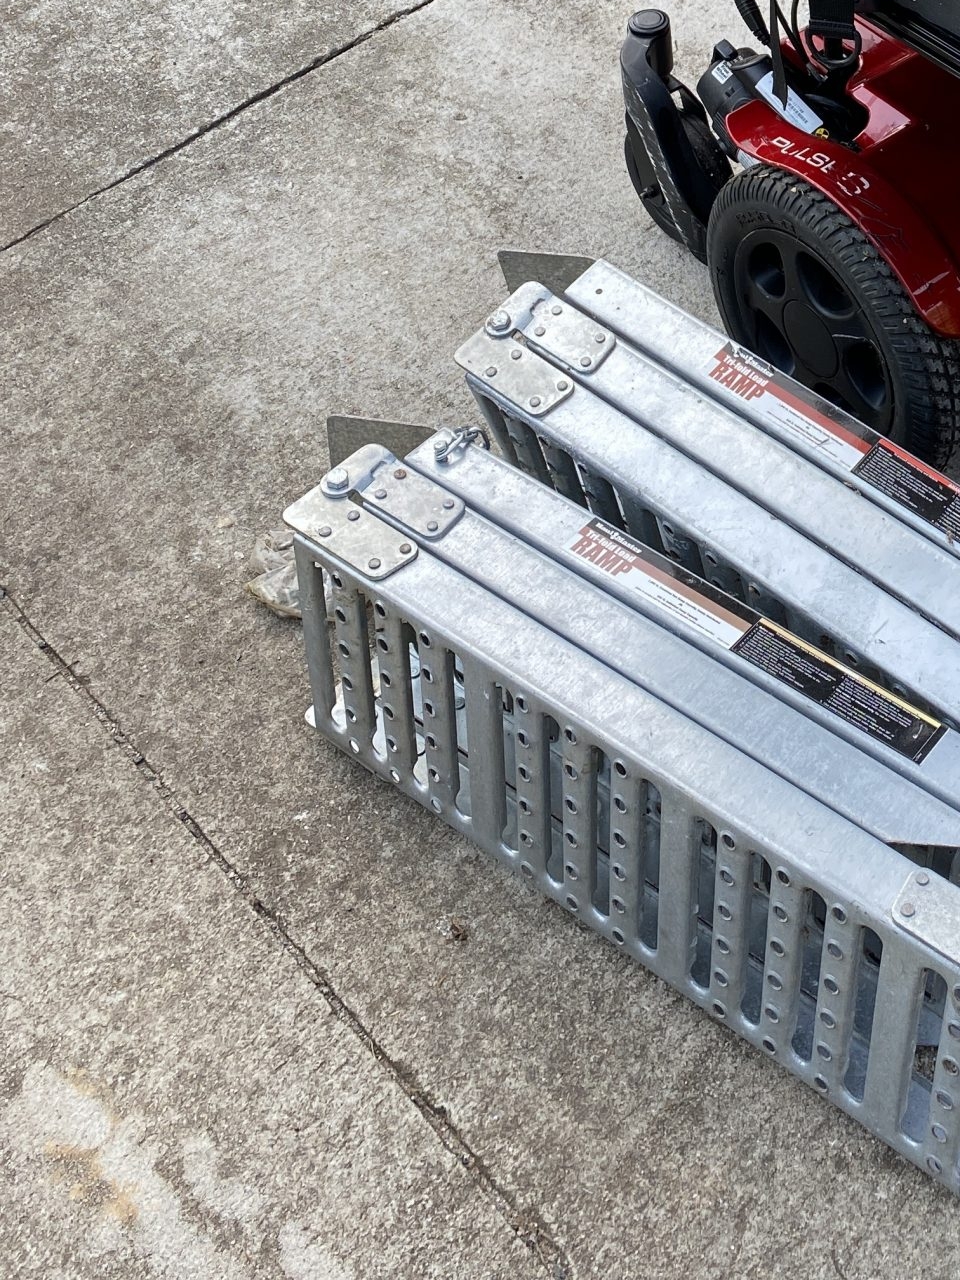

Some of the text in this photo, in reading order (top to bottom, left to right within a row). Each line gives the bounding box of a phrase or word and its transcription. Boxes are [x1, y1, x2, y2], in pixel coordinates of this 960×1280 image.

[708, 362, 765, 401] RAMP
[723, 354, 769, 387] Tri-fold Load
[570, 536, 633, 576] RAMP
[586, 529, 637, 563] Tri-fold Load
